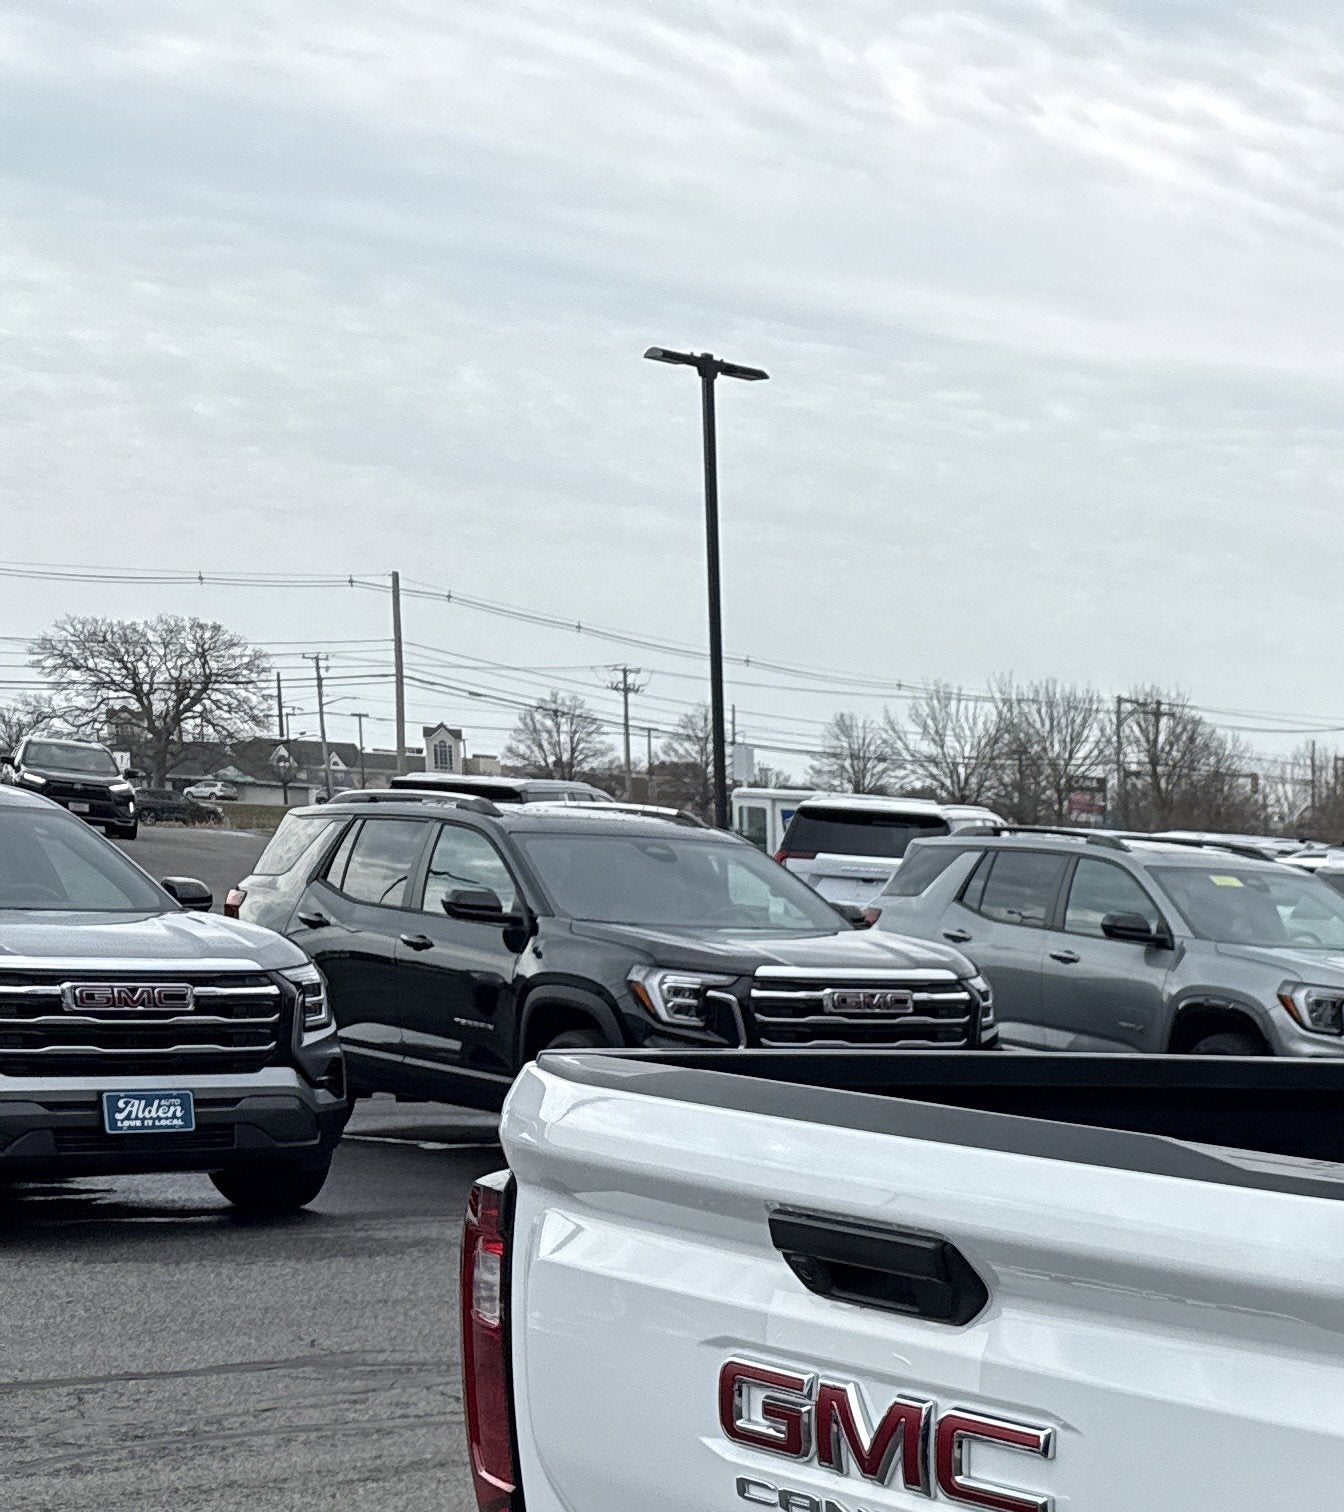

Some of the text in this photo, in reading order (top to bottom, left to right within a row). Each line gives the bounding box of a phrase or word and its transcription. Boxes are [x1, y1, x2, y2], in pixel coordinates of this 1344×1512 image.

[75, 986, 190, 1009] GMC
[833, 991, 910, 1010] GMC
[115, 1098, 185, 1120] Alden
[117, 1118, 184, 1127] LOVE IT LOCAL
